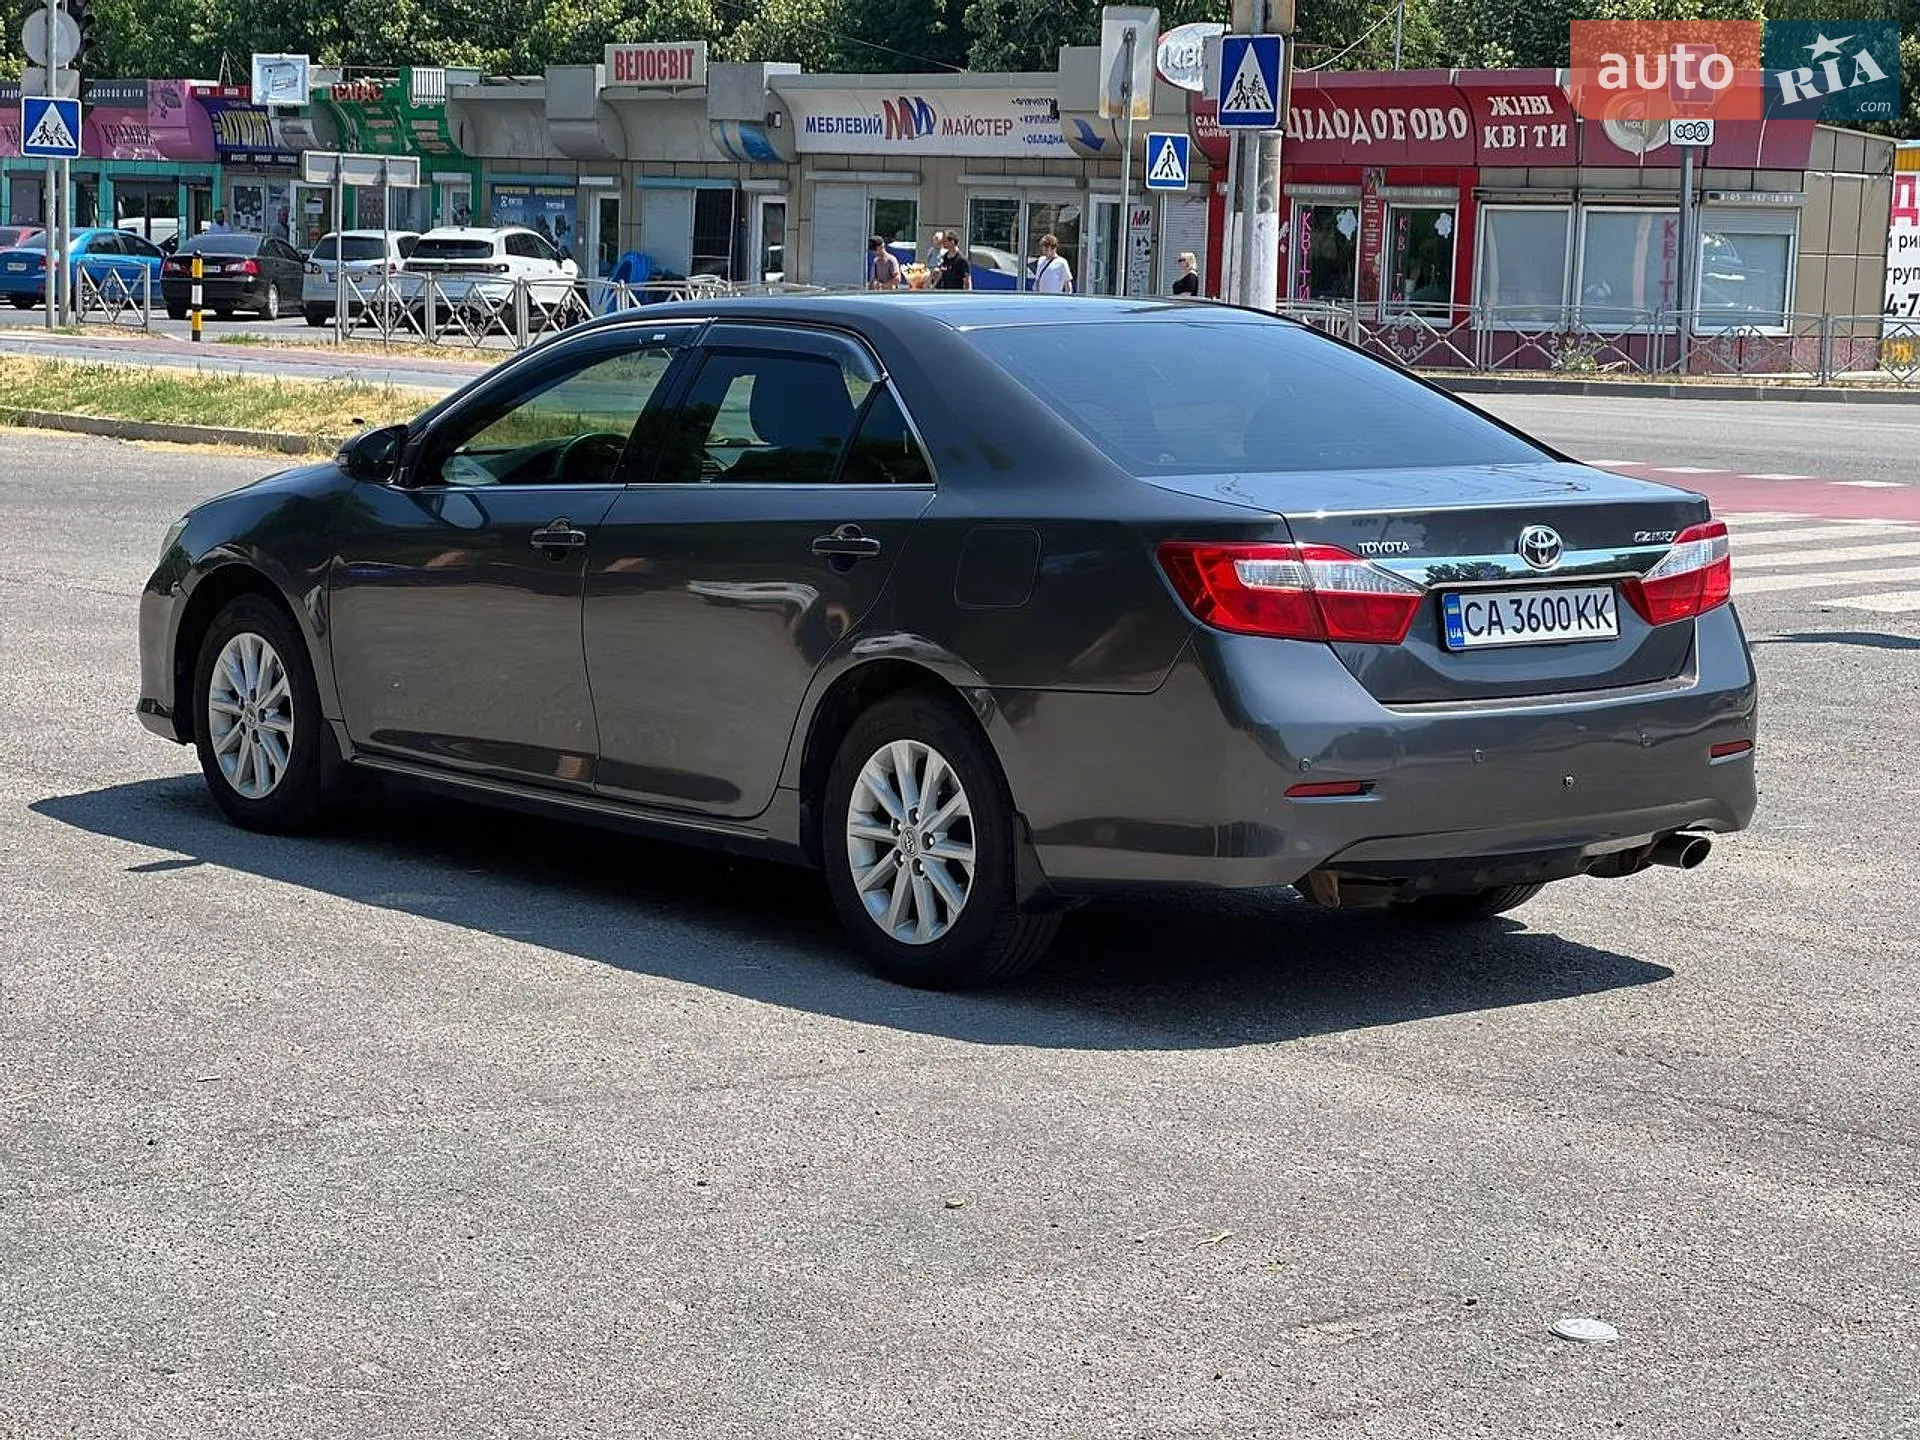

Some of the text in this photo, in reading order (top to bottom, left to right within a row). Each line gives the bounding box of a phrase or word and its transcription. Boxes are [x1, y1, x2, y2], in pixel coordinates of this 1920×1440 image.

[615, 48, 695, 81] ВЕЛОСВІТ
[1487, 95, 1554, 117] ЖИВІ
[805, 114, 883, 135] МЕБЛЕВИЙ
[941, 115, 1013, 137] МАЙСТЕР
[1287, 107, 1467, 145] ЦІЛОДОБОВО
[1483, 124, 1568, 149] КВІТИ
[1898, 234, 1920, 253] ри
[1884, 293, 1920, 317] 4-7
[1357, 541, 1410, 555] TOYOTA
[1464, 593, 1613, 637] CA 3600 KK
[1450, 629, 1463, 640] UA
